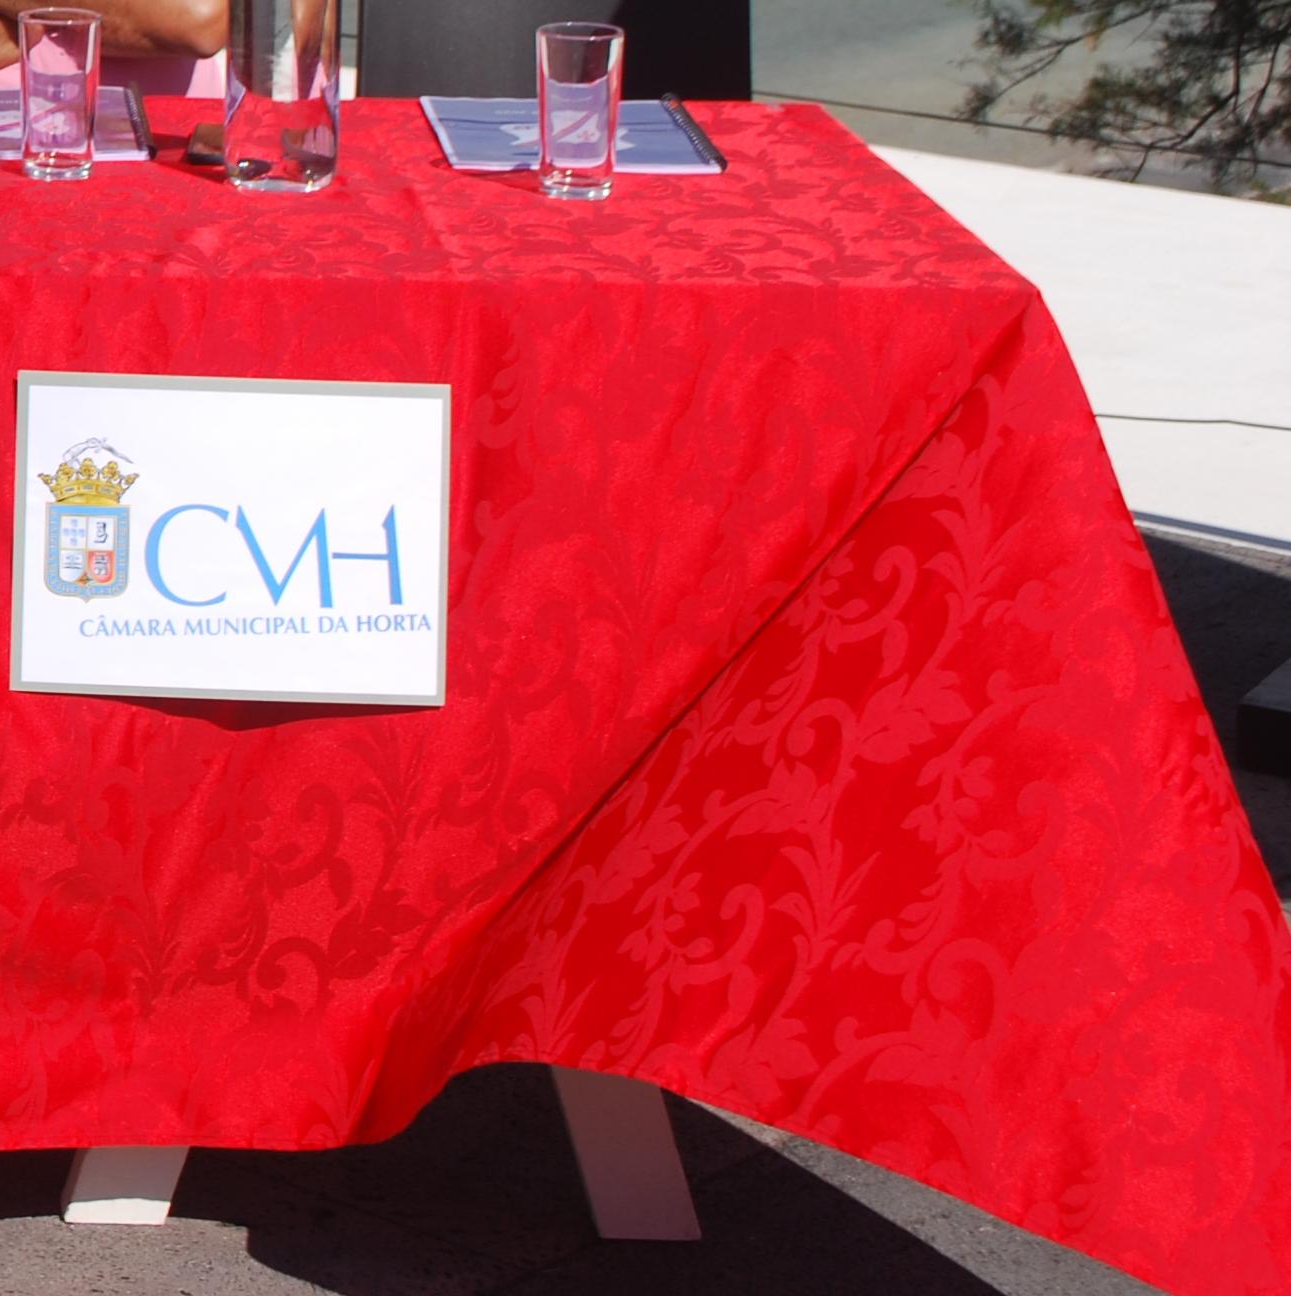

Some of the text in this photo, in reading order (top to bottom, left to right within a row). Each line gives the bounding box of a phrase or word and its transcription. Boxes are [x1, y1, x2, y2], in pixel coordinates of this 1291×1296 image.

[144, 504, 404, 609] CMH
[79, 613, 432, 638] CÂMARA MUNICIPAL DA HORTA
